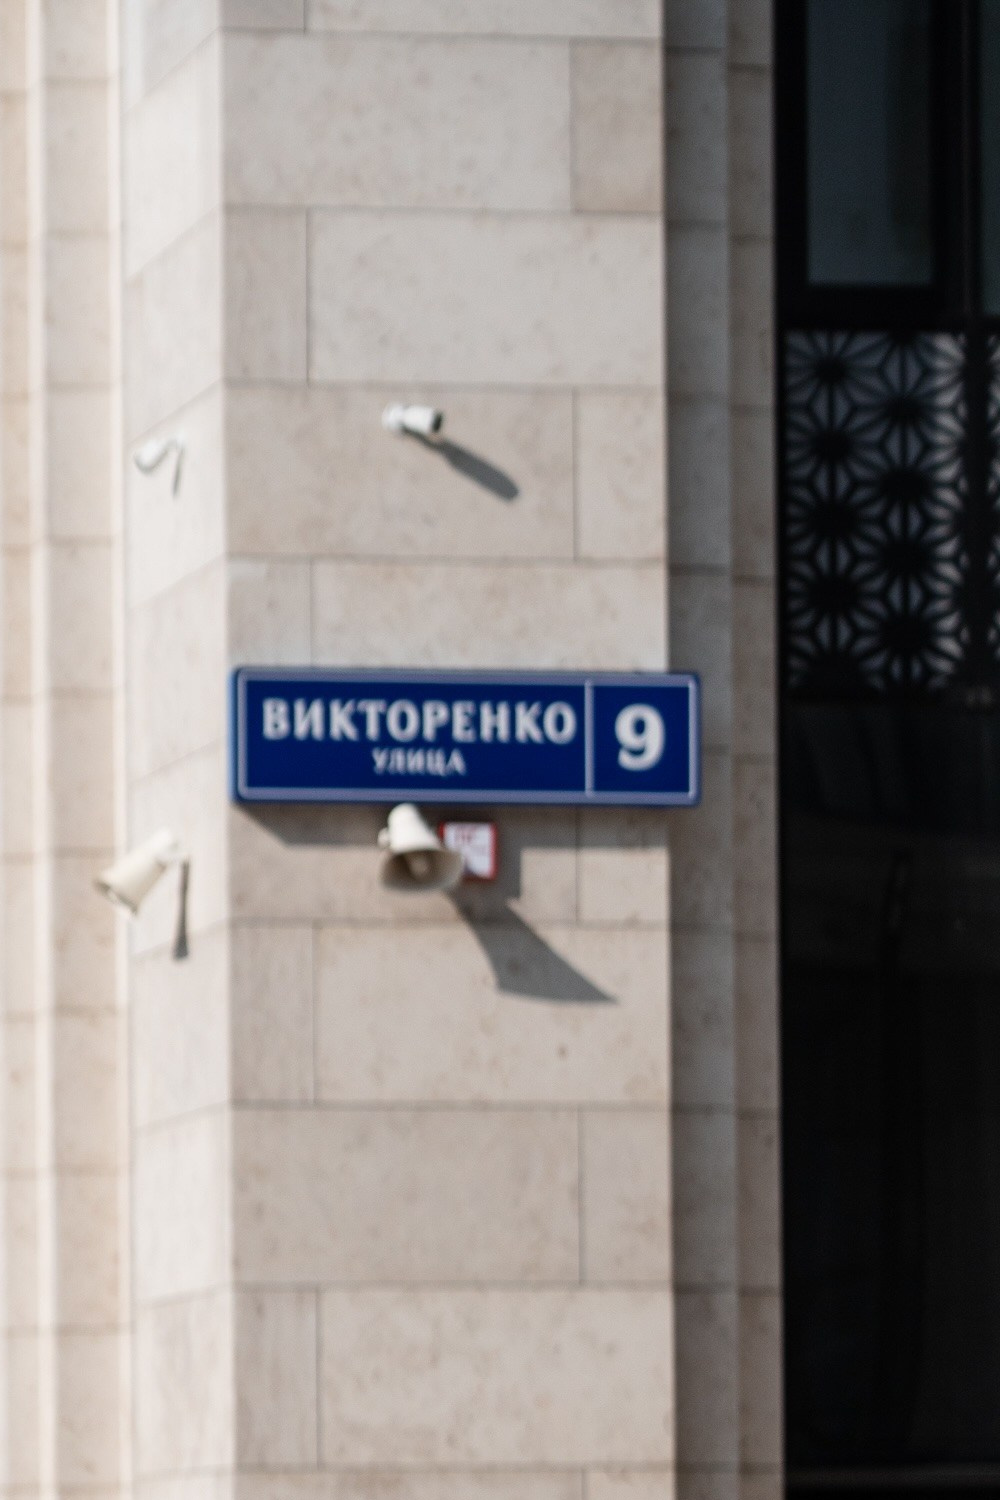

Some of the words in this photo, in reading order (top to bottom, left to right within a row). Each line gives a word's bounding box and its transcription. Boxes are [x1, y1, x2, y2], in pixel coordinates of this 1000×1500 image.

[262, 698, 577, 743] ВИКТОРЕНКО
[614, 704, 666, 771] 9
[372, 747, 467, 776] УЛИЦА
